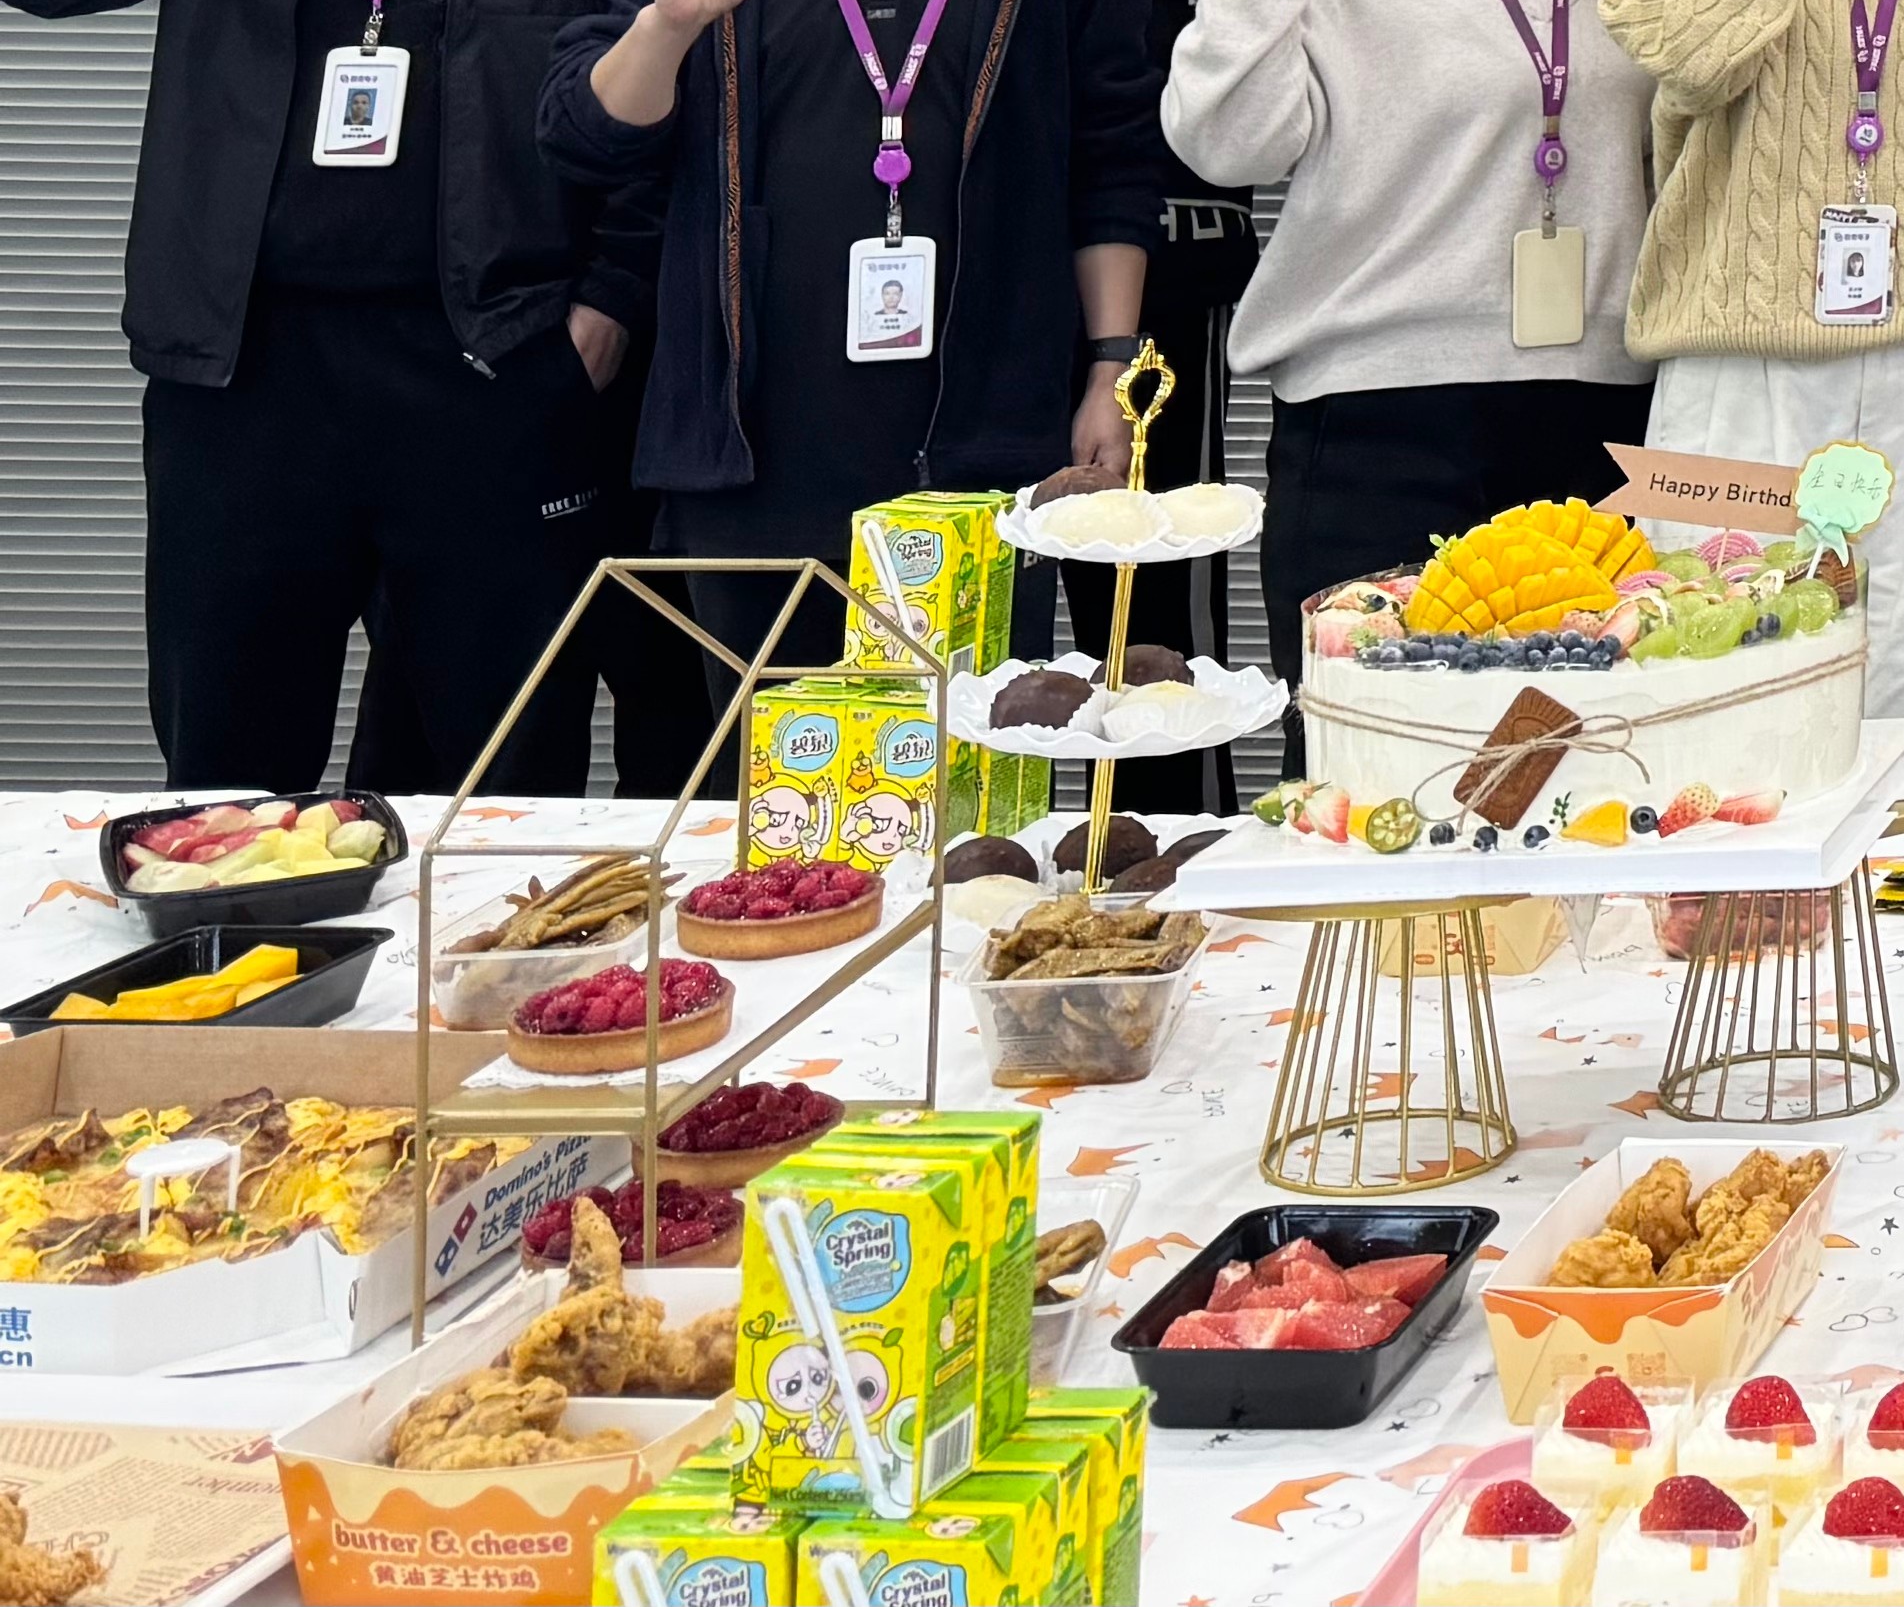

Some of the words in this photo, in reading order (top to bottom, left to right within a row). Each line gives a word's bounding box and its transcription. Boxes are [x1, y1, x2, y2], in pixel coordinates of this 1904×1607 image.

[1649, 473, 1719, 502] Happy
[1726, 483, 1792, 507] Birthd
[484, 1150, 551, 1211] Domino's
[826, 1222, 889, 1252] Crystal
[833, 1243, 892, 1269] Spring
[334, 1523, 417, 1554] butter
[430, 1529, 459, 1555] &
[471, 1533, 569, 1555] cheese
[374, 1565, 537, 1589] 黄油芝士炸鸡
[679, 1570, 745, 1597] Crystal
[881, 1573, 946, 1601] Crystal
